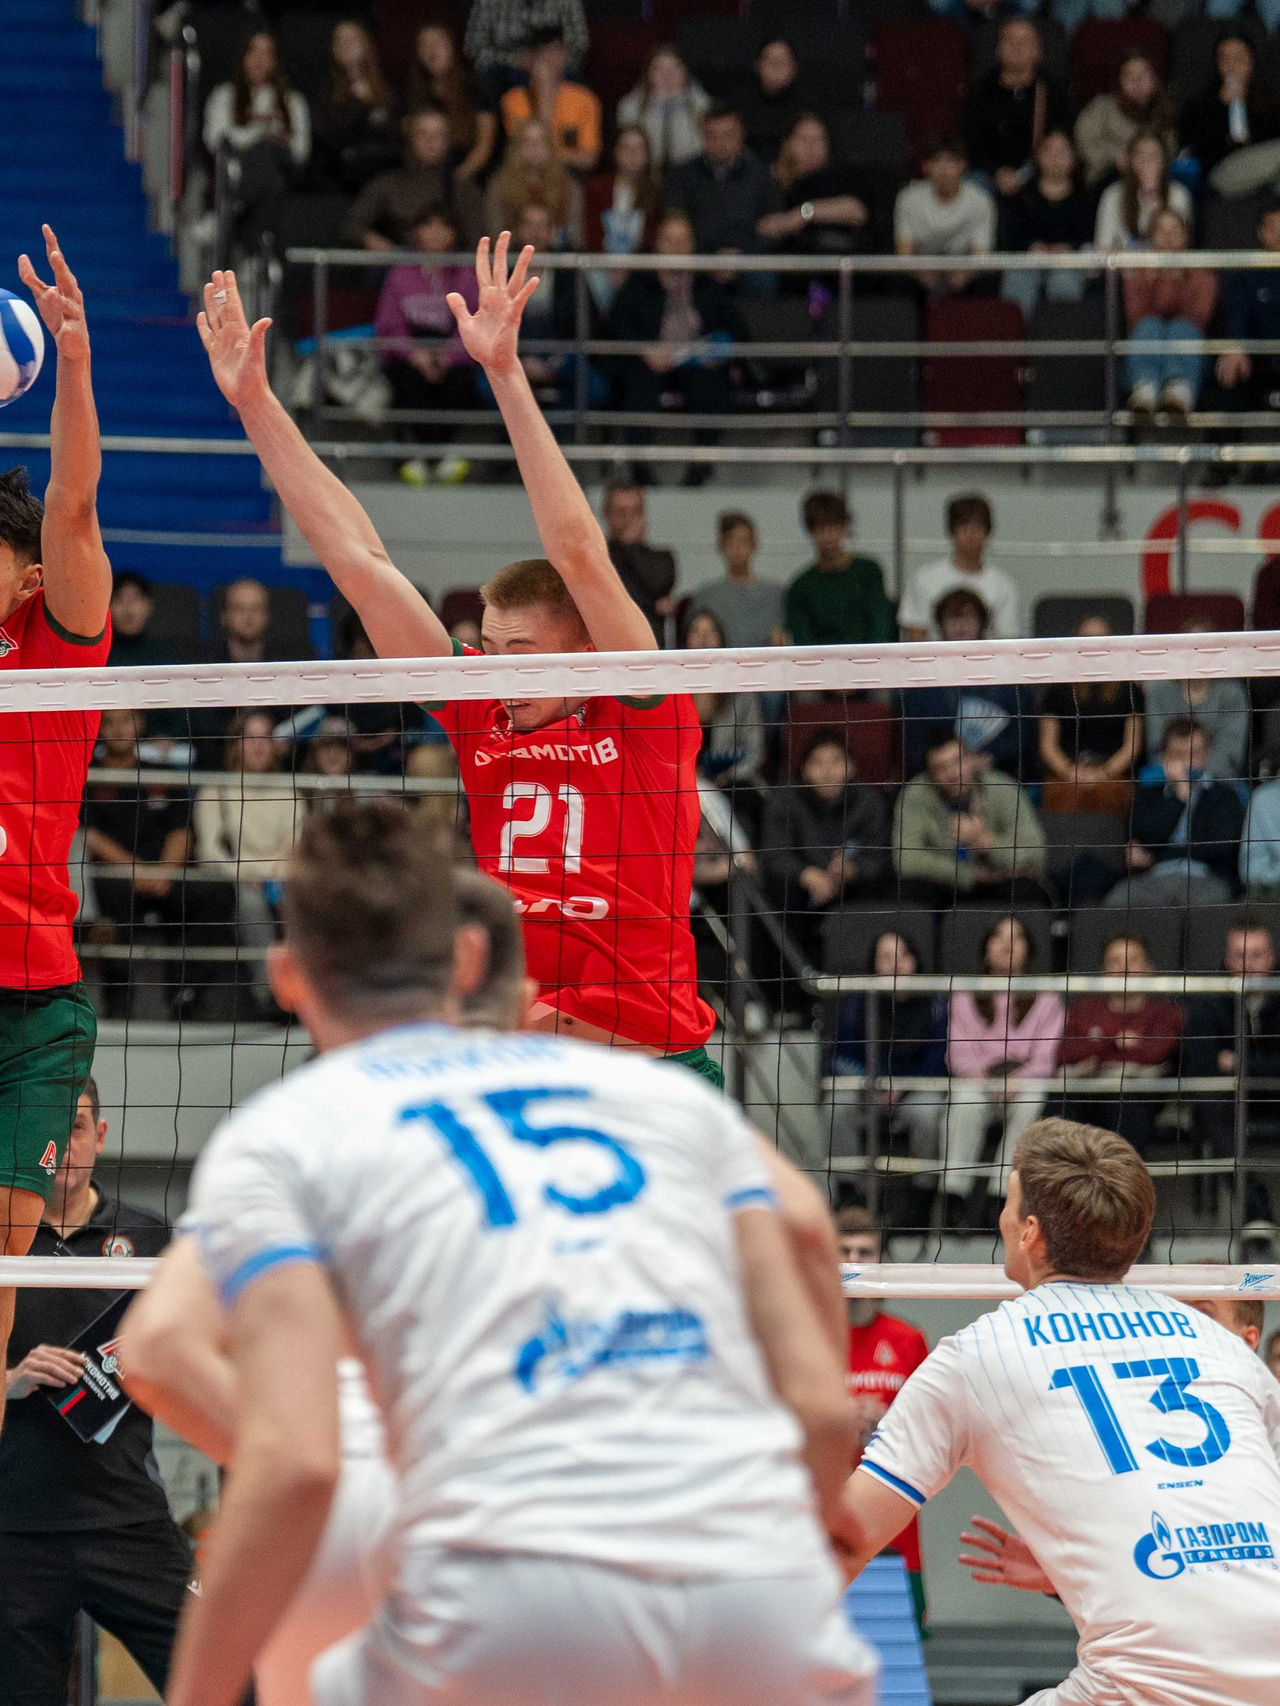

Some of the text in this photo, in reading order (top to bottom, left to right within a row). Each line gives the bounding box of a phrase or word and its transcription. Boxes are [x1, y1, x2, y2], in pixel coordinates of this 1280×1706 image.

[498, 781, 585, 875] 21
[398, 1087, 646, 1229] 15
[1023, 1311, 1197, 1346] КОНОНОВ
[1048, 1357, 1231, 1476] 13
[1157, 1480, 1204, 1490] ENSEN
[1175, 1521, 1270, 1549] ГАЗПРОМ
[1186, 1547, 1273, 1562] ТРАНСГАЗ
